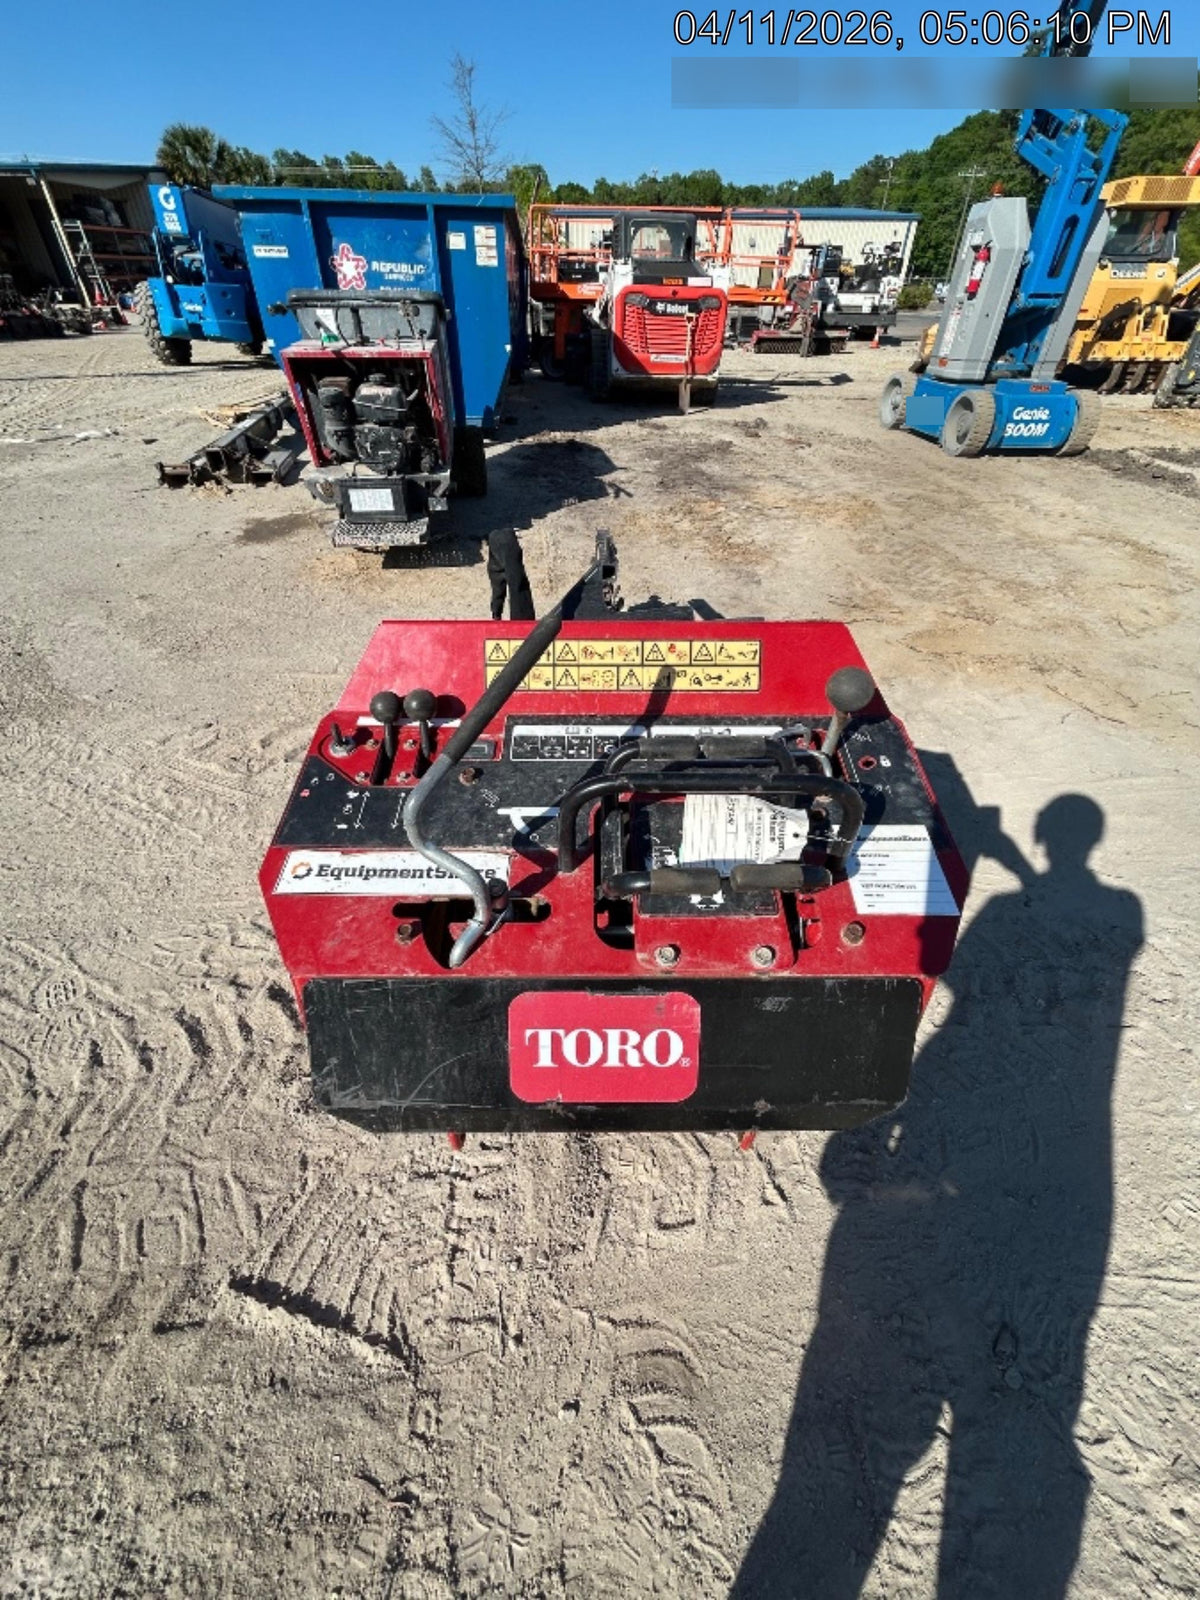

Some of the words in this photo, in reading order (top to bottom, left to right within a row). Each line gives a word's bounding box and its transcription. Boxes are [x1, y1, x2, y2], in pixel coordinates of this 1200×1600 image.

[371, 261, 427, 274] REPUBLIC
[1013, 406, 1050, 420] Genie
[525, 1028, 684, 1068] TORO
